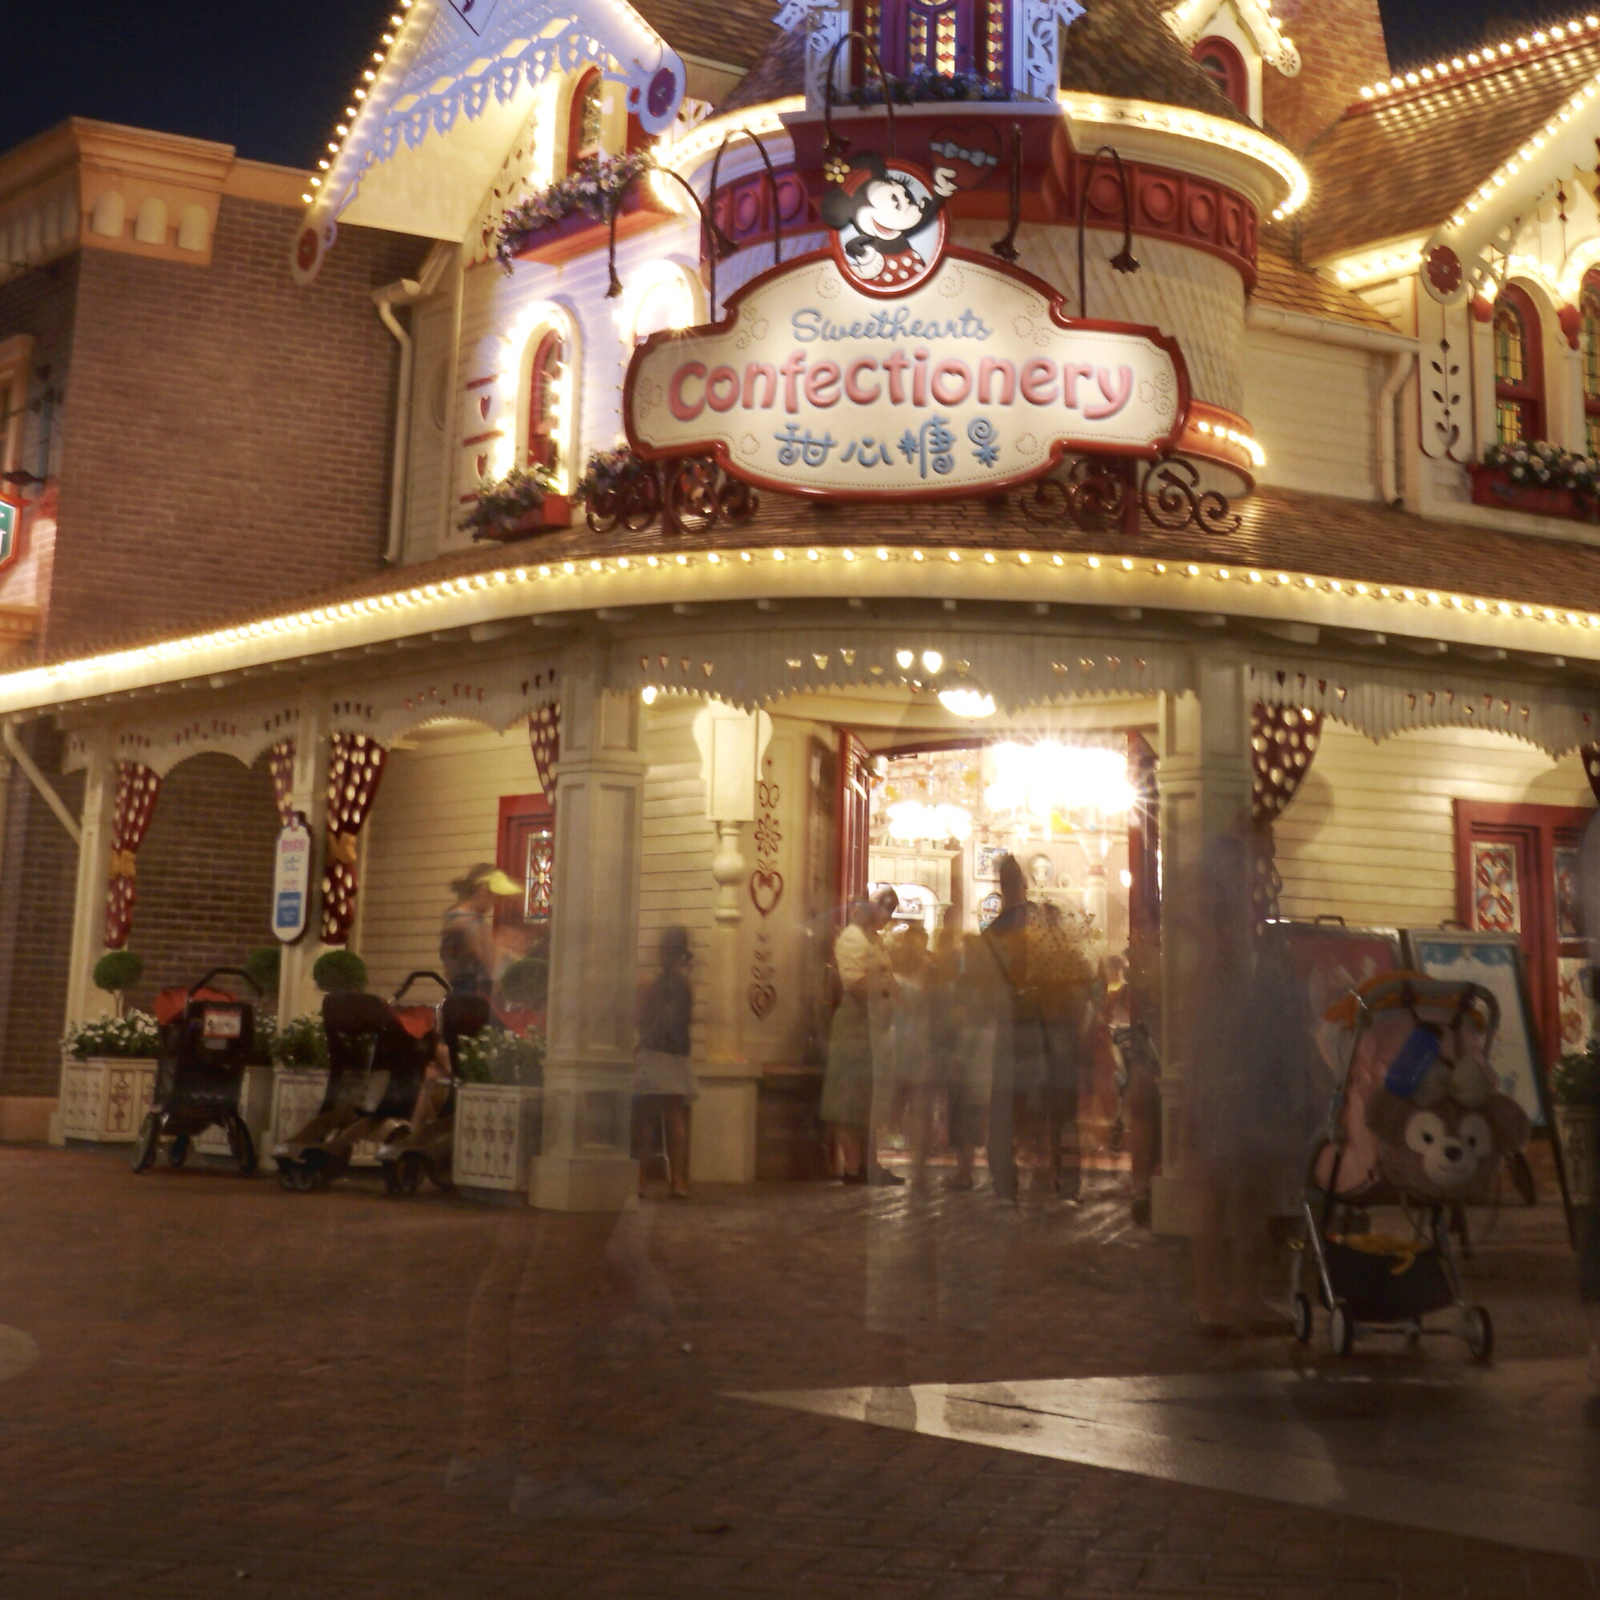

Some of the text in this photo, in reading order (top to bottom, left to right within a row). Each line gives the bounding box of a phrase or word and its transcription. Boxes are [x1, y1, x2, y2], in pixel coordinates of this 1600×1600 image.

[791, 306, 994, 343] Sweethearts
[774, 413, 1002, 479] 甜心糖果
